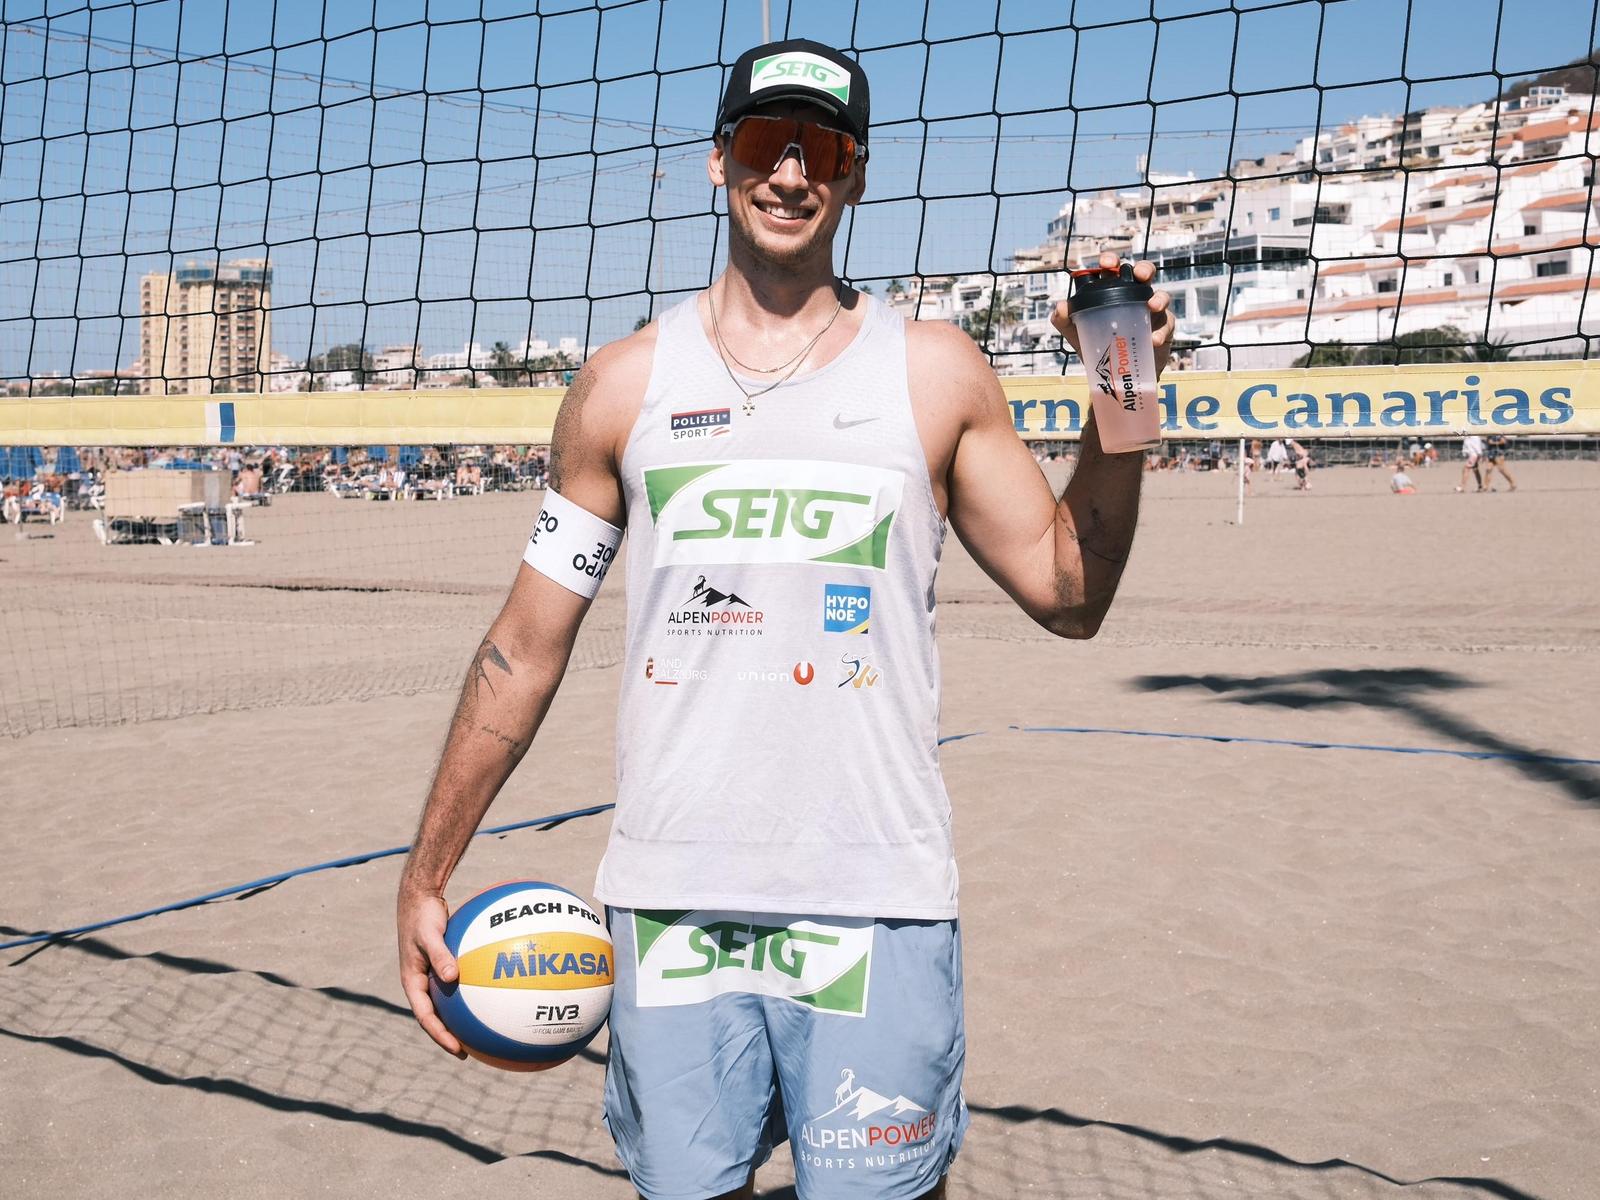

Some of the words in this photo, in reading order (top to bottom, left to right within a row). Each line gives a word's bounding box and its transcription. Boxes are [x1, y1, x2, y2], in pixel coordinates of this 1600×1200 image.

[1115, 335, 1137, 411] AlpenPower
[1008, 399, 1083, 432] rn
[1237, 375, 1575, 430] Canarias
[673, 414, 720, 427] POLIZEI
[673, 428, 708, 440] SPORT
[538, 509, 559, 533] PO
[572, 553, 608, 580] YPO
[826, 595, 869, 610] HYPO
[826, 608, 856, 622] NOE
[667, 611, 764, 624] ALPENPOWER
[489, 902, 562, 929] BEACH
[567, 904, 601, 925] PRO
[801, 1112, 937, 1149] ALPENPOWER
[801, 1151, 855, 1169] SPORTS
[865, 1137, 936, 1168] NUTRITION
